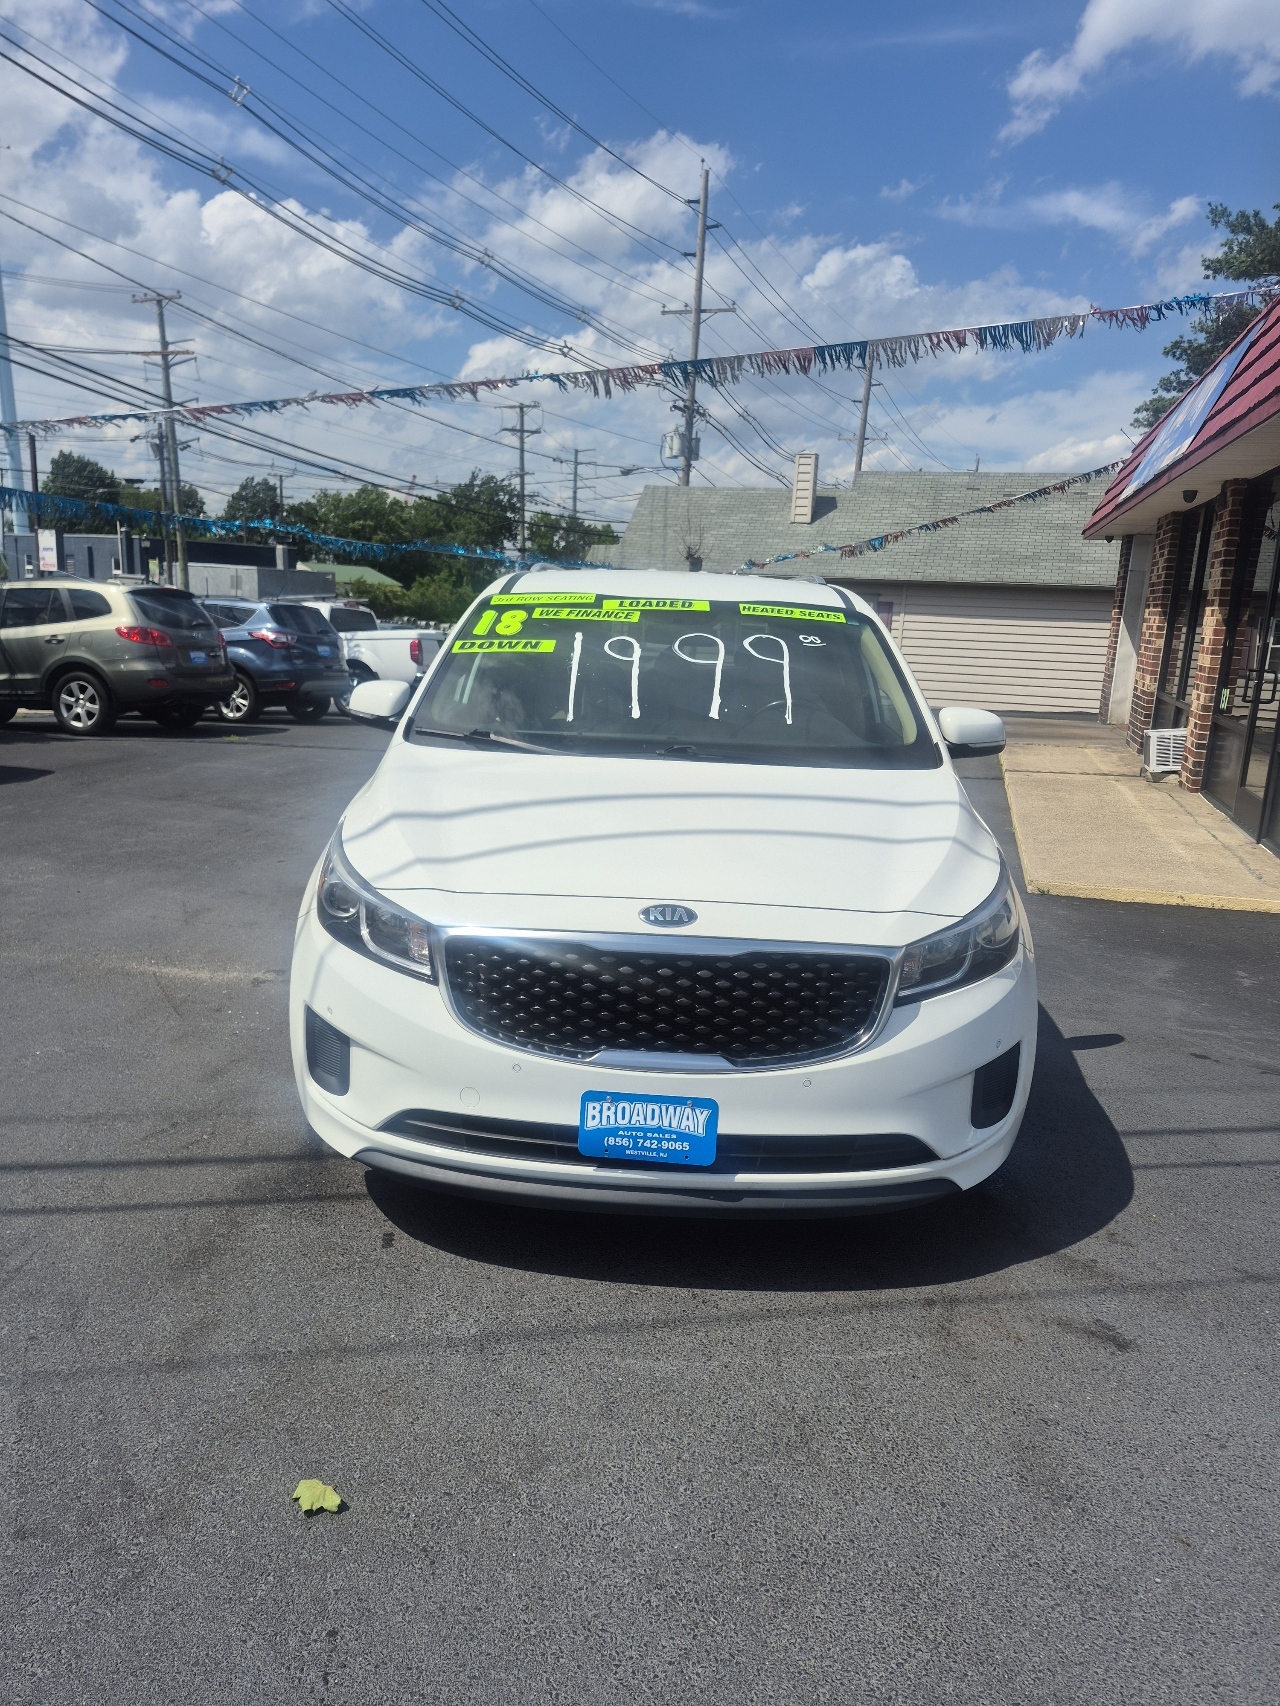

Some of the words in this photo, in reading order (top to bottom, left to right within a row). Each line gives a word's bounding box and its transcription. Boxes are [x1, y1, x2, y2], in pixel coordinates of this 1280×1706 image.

[617, 599, 694, 609] LOADED
[540, 609, 564, 617] WE
[565, 609, 635, 620] FINANCE
[741, 604, 795, 616] HEATED
[799, 609, 842, 620] SEATS
[472, 609, 529, 636] 18
[459, 639, 543, 651] DOWN
[566, 631, 793, 725] 1999
[649, 907, 689, 922] KIA
[584, 1101, 712, 1137] BROADWAY
[604, 1136, 633, 1149] (856)
[636, 1138, 690, 1151] 742-9065
[625, 1149, 659, 1157] WESTVILLE,
